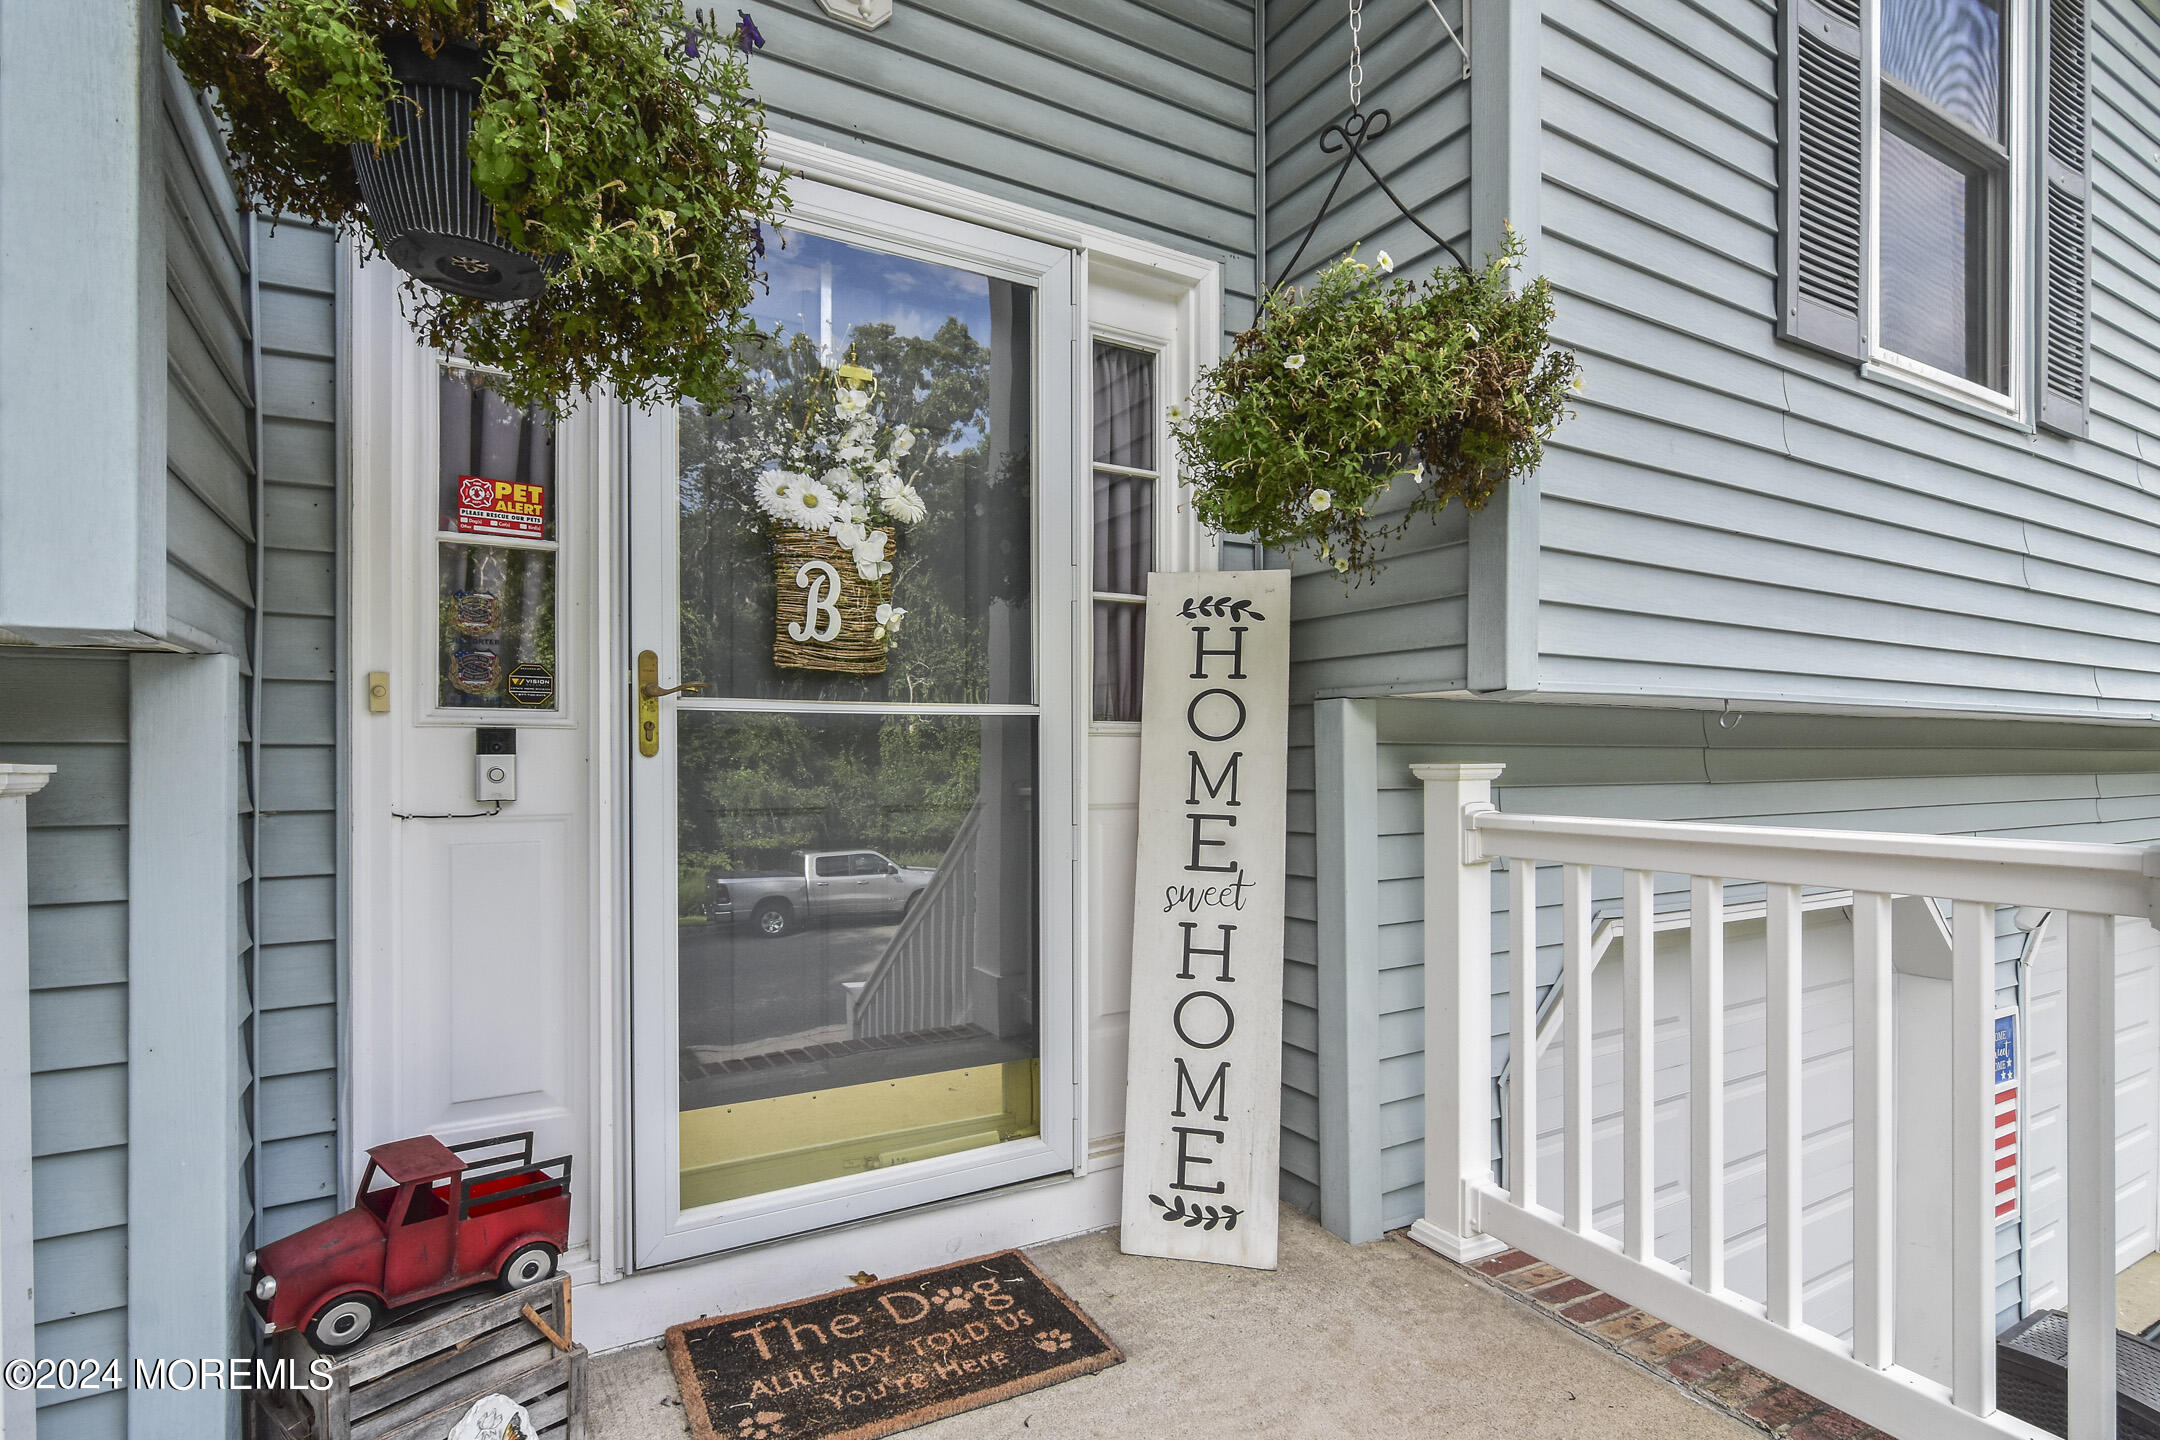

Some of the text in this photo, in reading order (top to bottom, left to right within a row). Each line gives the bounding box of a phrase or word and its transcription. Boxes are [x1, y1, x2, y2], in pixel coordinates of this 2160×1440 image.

[495, 481, 543, 504] PET
[495, 501, 543, 515] ALERT
[461, 509, 484, 517] PLEASE
[788, 560, 841, 642] B
[1183, 626, 1249, 873] HOME
[1163, 869, 1256, 913] sweet
[1994, 1030, 2007, 1041] OME
[1994, 1040, 2012, 1059] eet
[1169, 921, 1238, 1194] HOME
[1994, 1060, 2007, 1071] OME
[731, 1277, 1015, 1360] The Dg
[750, 1309, 1035, 1400] ALREADY TOLD US
